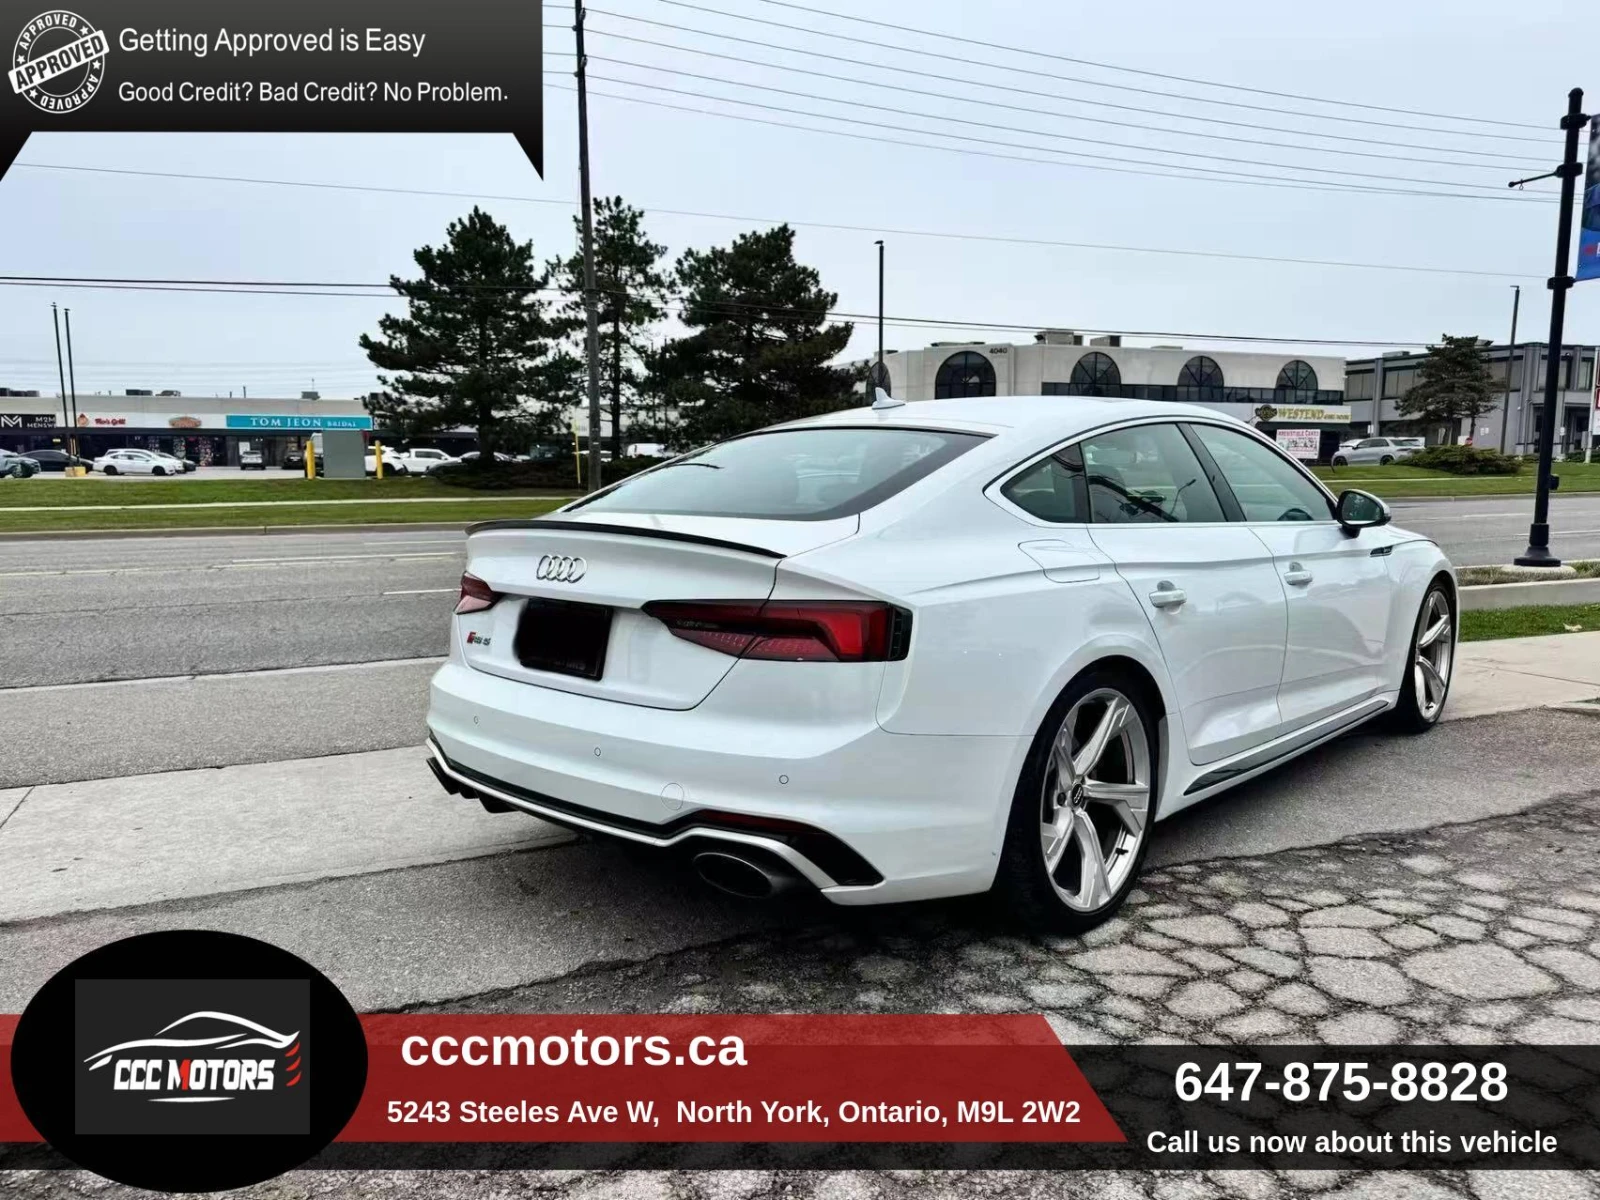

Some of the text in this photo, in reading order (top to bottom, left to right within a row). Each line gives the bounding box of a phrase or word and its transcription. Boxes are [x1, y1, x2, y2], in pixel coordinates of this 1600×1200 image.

[1277, 407, 1325, 420] WESTEND
[250, 417, 357, 428] TOM JEON BRIDAL
